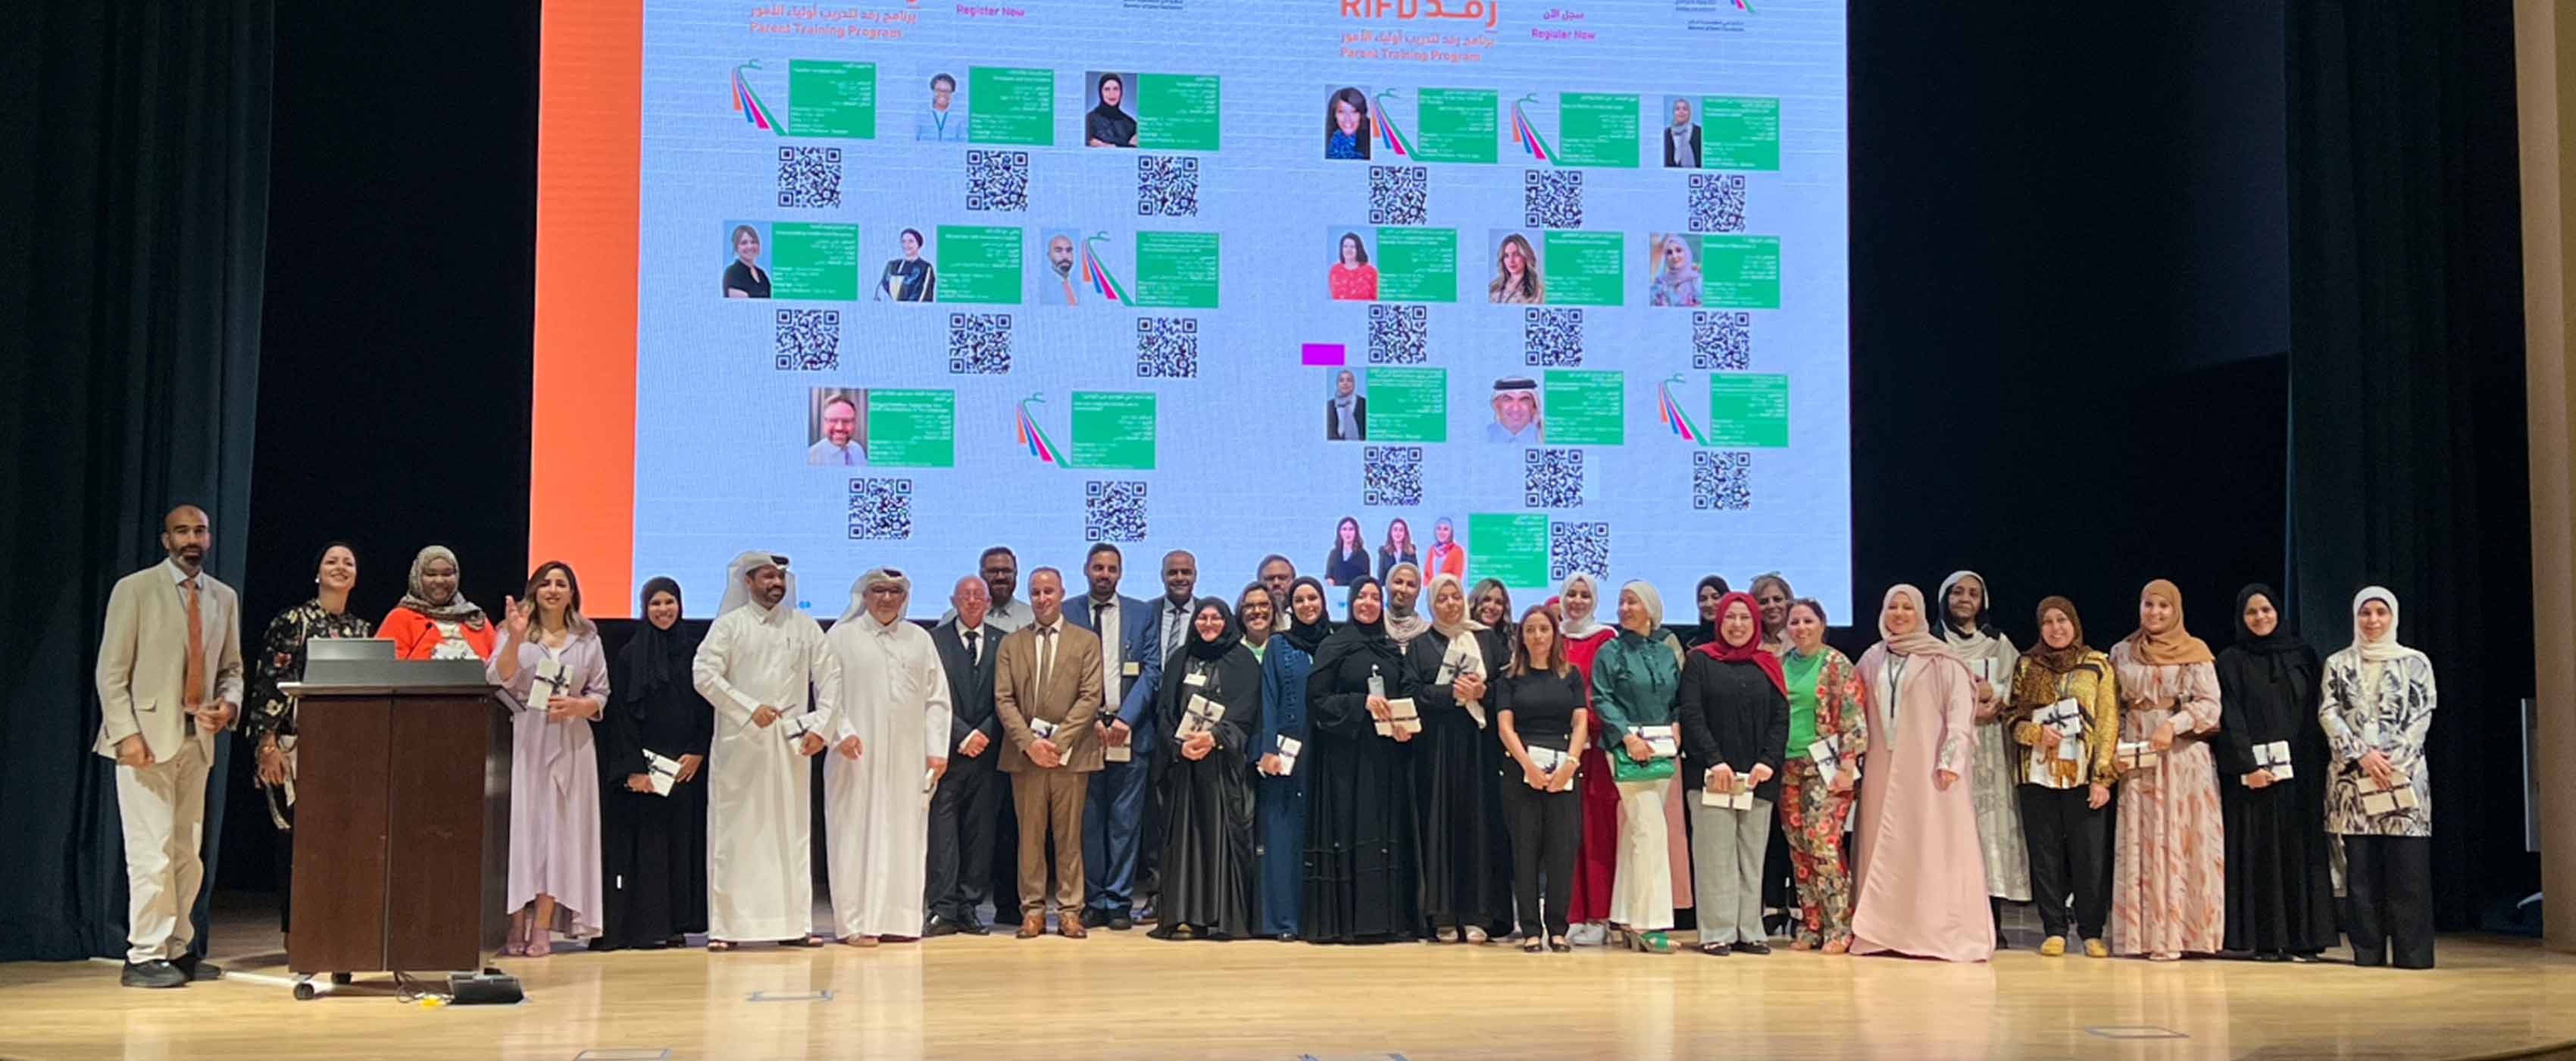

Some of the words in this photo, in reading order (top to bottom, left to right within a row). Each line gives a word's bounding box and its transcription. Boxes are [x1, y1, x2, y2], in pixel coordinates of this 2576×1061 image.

[957, 3, 999, 17] Register
[1002, 7, 1024, 17] Now
[751, 22, 789, 34] Parent
[794, 24, 846, 39] Training
[848, 25, 902, 39] Program
[1531, 28, 1571, 41] Register
[1574, 31, 1597, 40] Now
[1340, 48, 1378, 59] Parent
[1382, 49, 1428, 63] Training
[1430, 50, 1481, 64] Program
